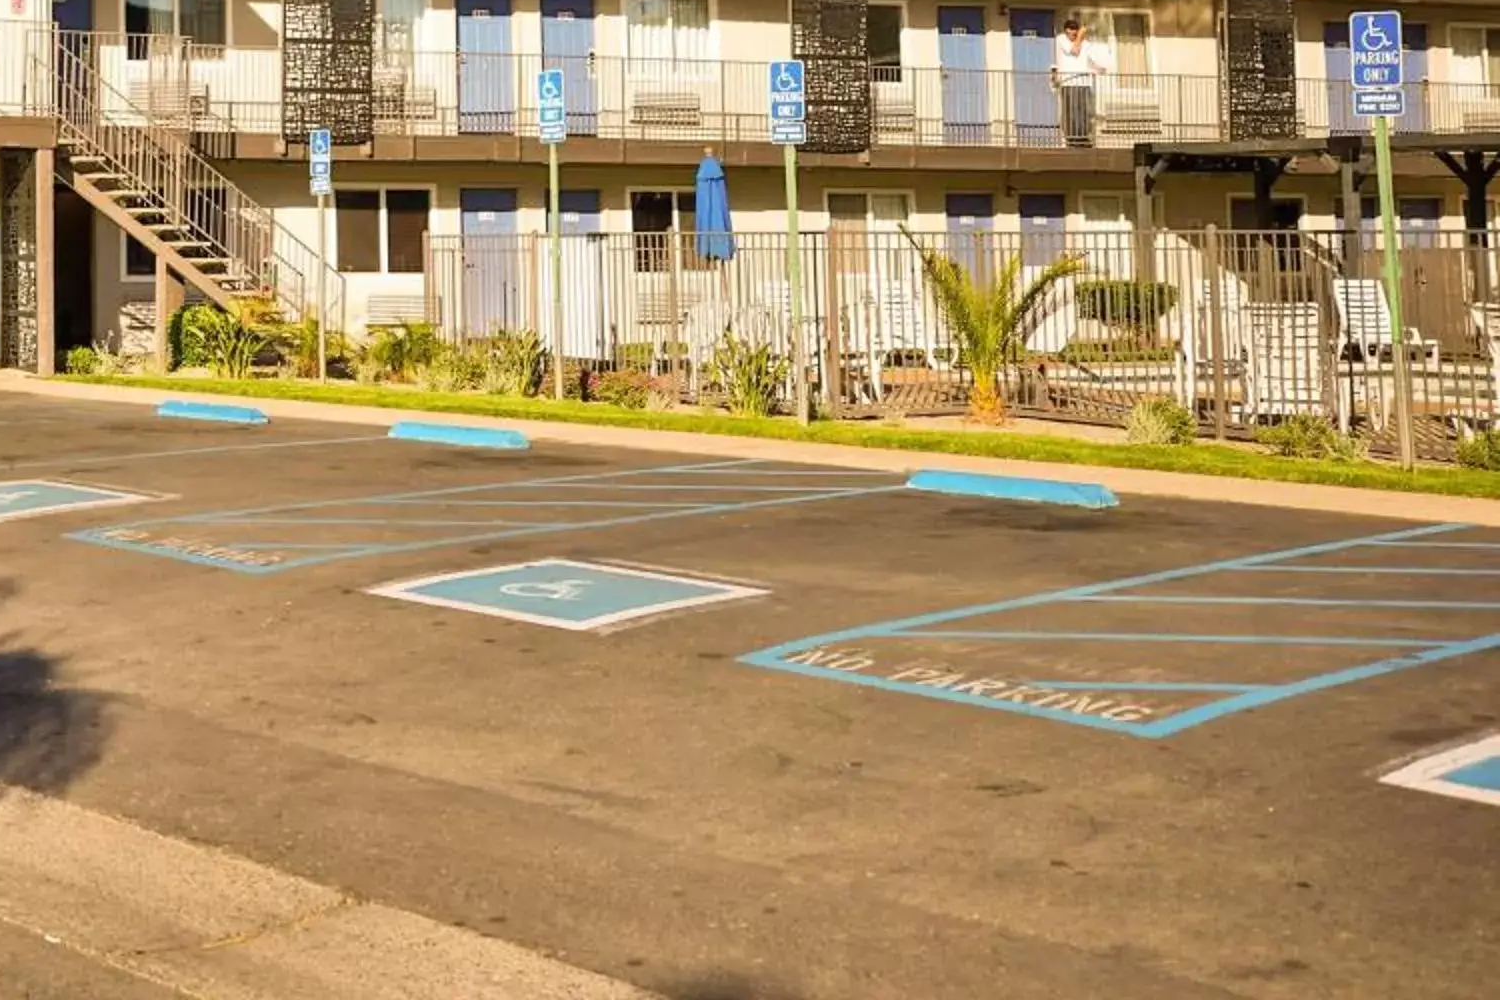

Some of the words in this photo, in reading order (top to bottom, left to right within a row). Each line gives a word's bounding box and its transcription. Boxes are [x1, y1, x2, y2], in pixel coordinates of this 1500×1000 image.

[1355, 51, 1399, 65] PARKING
[1363, 67, 1389, 82] ONLY
[785, 648, 874, 671] NO
[887, 667, 1154, 721] PARKING
